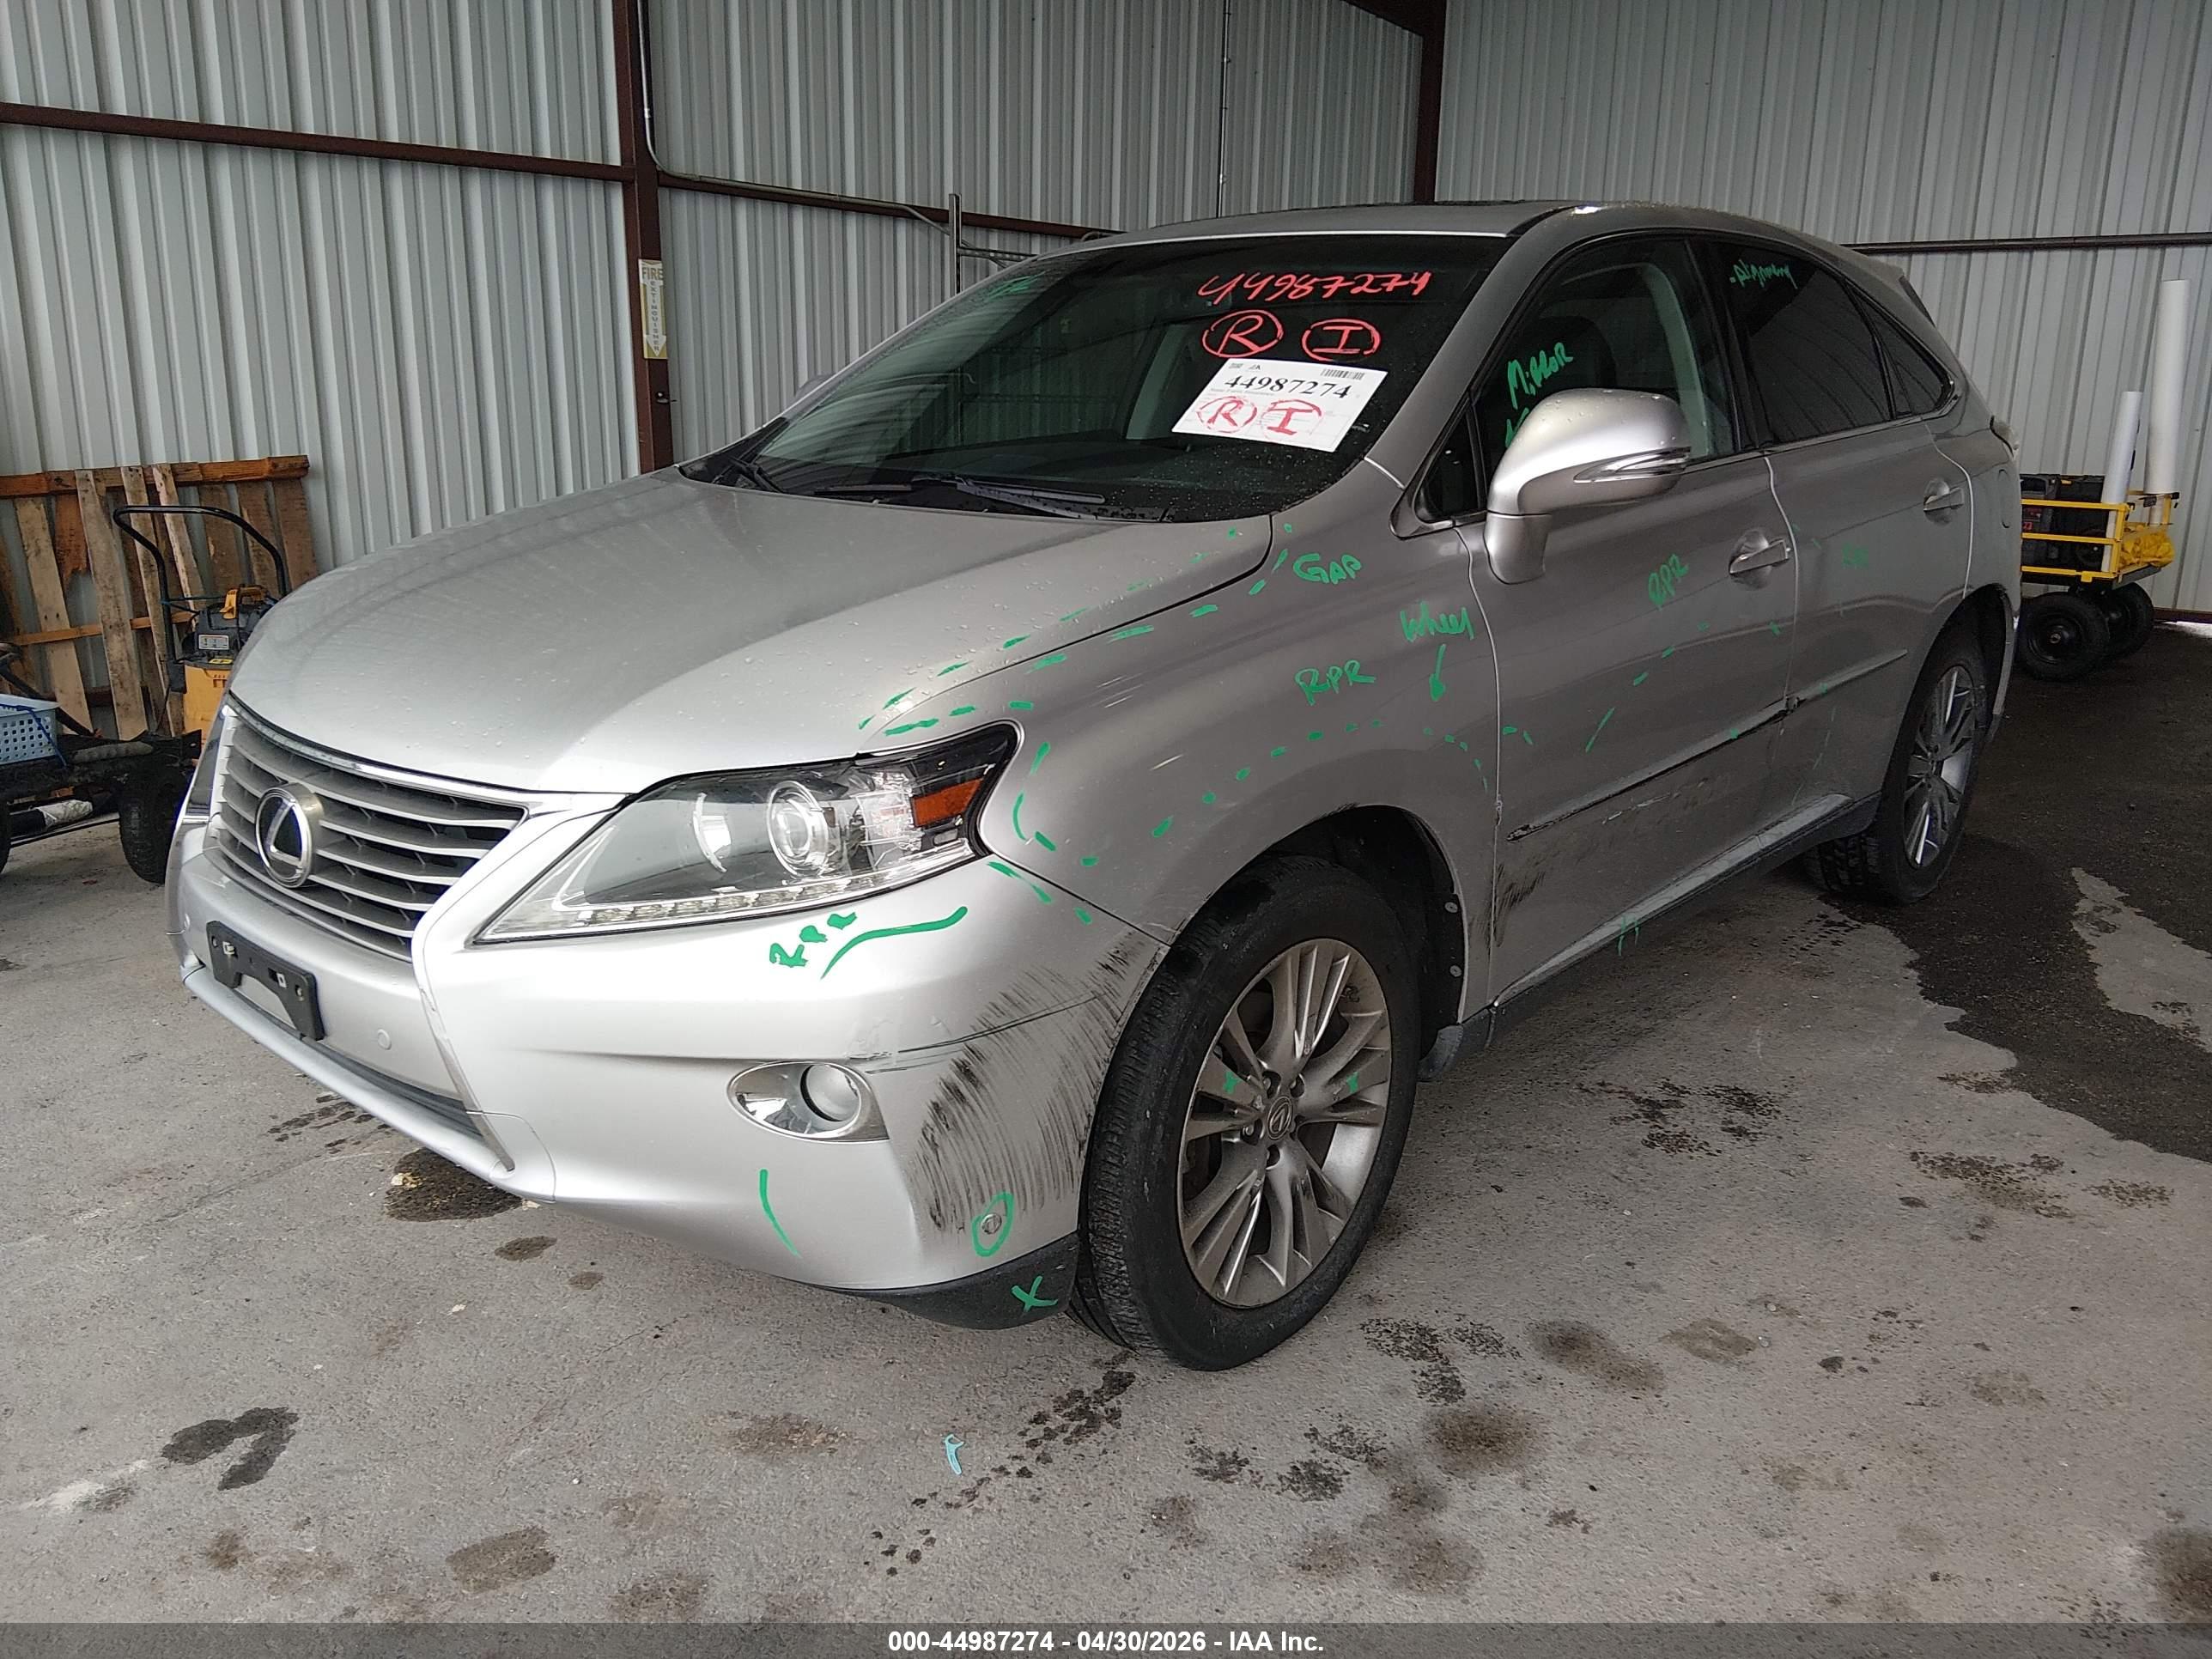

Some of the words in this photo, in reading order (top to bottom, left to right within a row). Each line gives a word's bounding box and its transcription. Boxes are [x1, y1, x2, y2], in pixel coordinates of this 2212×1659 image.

[641, 266, 664, 281] FIRE
[1197, 270, 1433, 306] 44987274
[1224, 374, 1353, 399] 44987274
[1292, 553, 1363, 585] GAP
[1294, 659, 1376, 706] RPR
